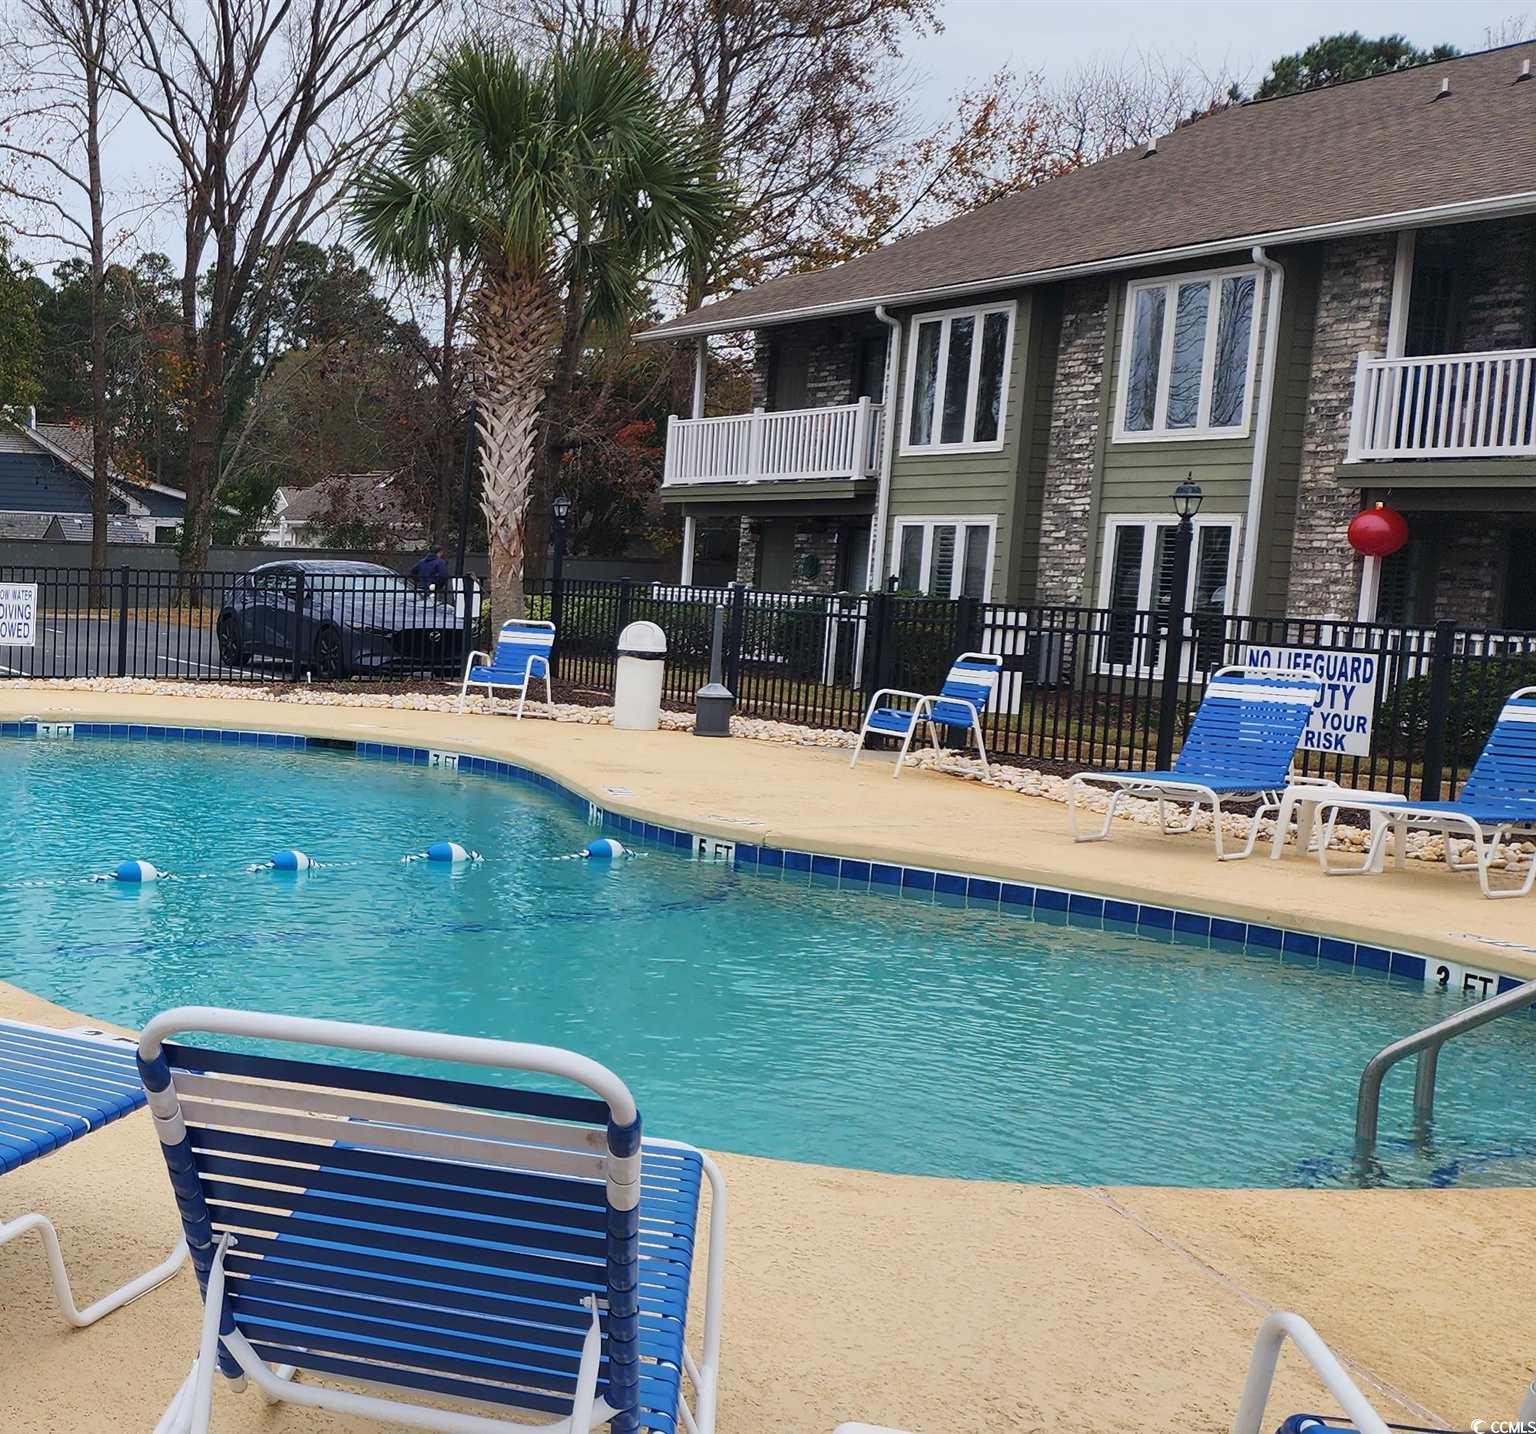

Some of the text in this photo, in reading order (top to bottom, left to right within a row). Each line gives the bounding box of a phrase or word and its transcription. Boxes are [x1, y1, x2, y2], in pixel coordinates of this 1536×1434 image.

[12, 590, 33, 601] WATER
[1248, 649, 1374, 684] NO LIFEGUARD
[1321, 712, 1367, 734] YOUR
[1304, 730, 1346, 752] RISK
[714, 843, 733, 861] FT
[1464, 973, 1494, 1000] FT
